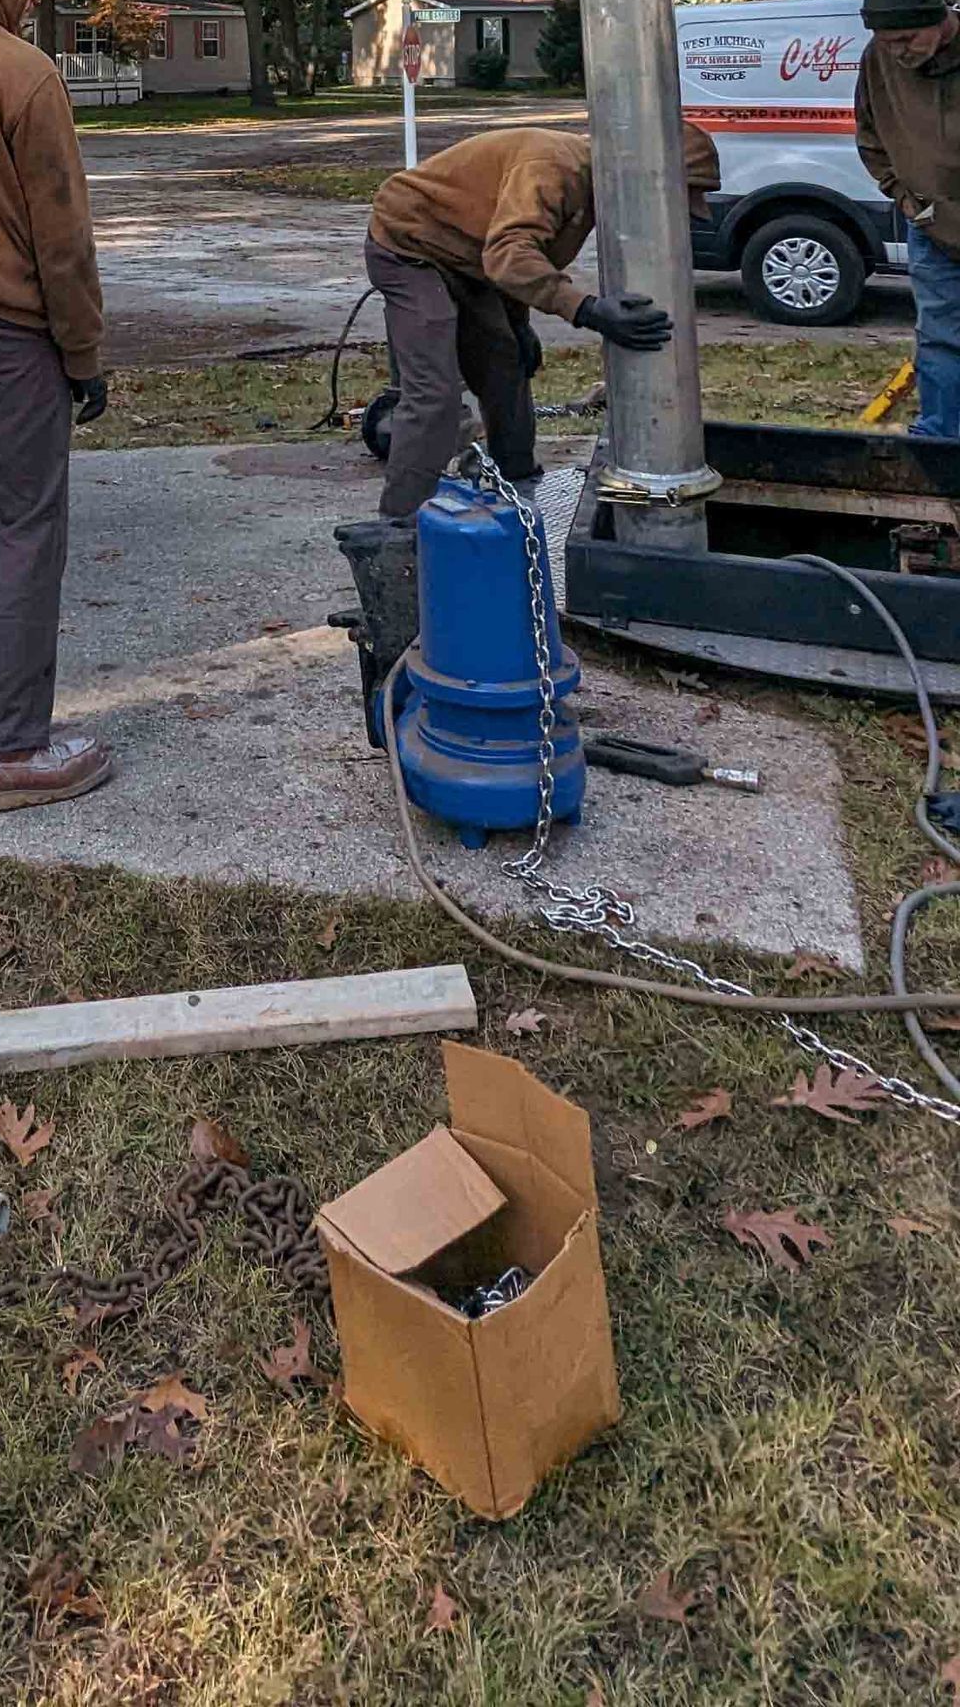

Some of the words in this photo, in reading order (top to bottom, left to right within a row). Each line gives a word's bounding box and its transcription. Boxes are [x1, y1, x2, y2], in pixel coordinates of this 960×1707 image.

[415, 10, 430, 20] PARK
[432, 9, 458, 20] ESTATES
[682, 37, 711, 50] WEST
[714, 35, 766, 49] MICHIGAN
[403, 44, 421, 66] STOP
[740, 55, 761, 64] DRAIN
[780, 35, 856, 82] City
[700, 70, 746, 81] SERVICE
